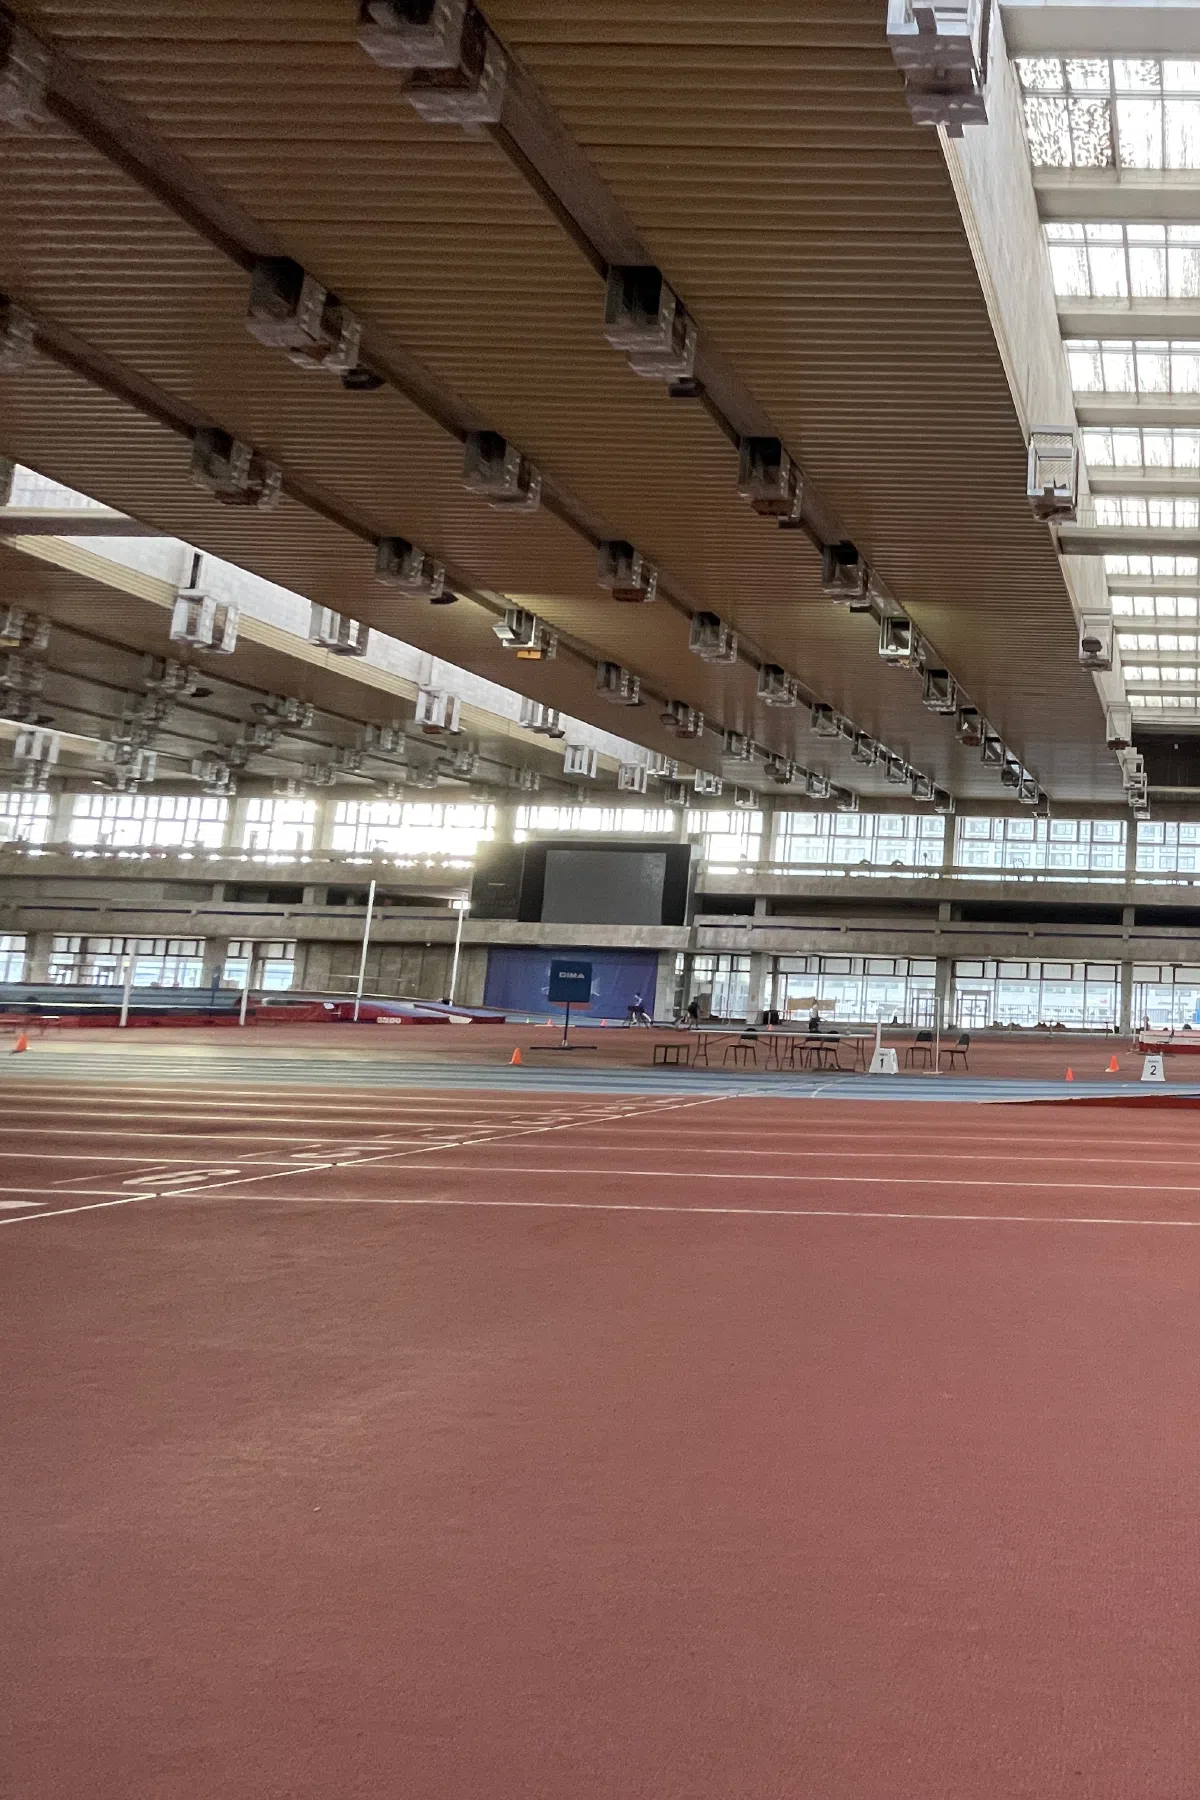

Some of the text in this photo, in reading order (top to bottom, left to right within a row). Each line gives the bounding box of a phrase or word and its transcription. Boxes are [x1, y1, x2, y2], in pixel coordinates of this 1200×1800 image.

[559, 971, 585, 979] DIMA
[880, 1058, 884, 1068] 1
[1150, 1065, 1157, 1076] 2
